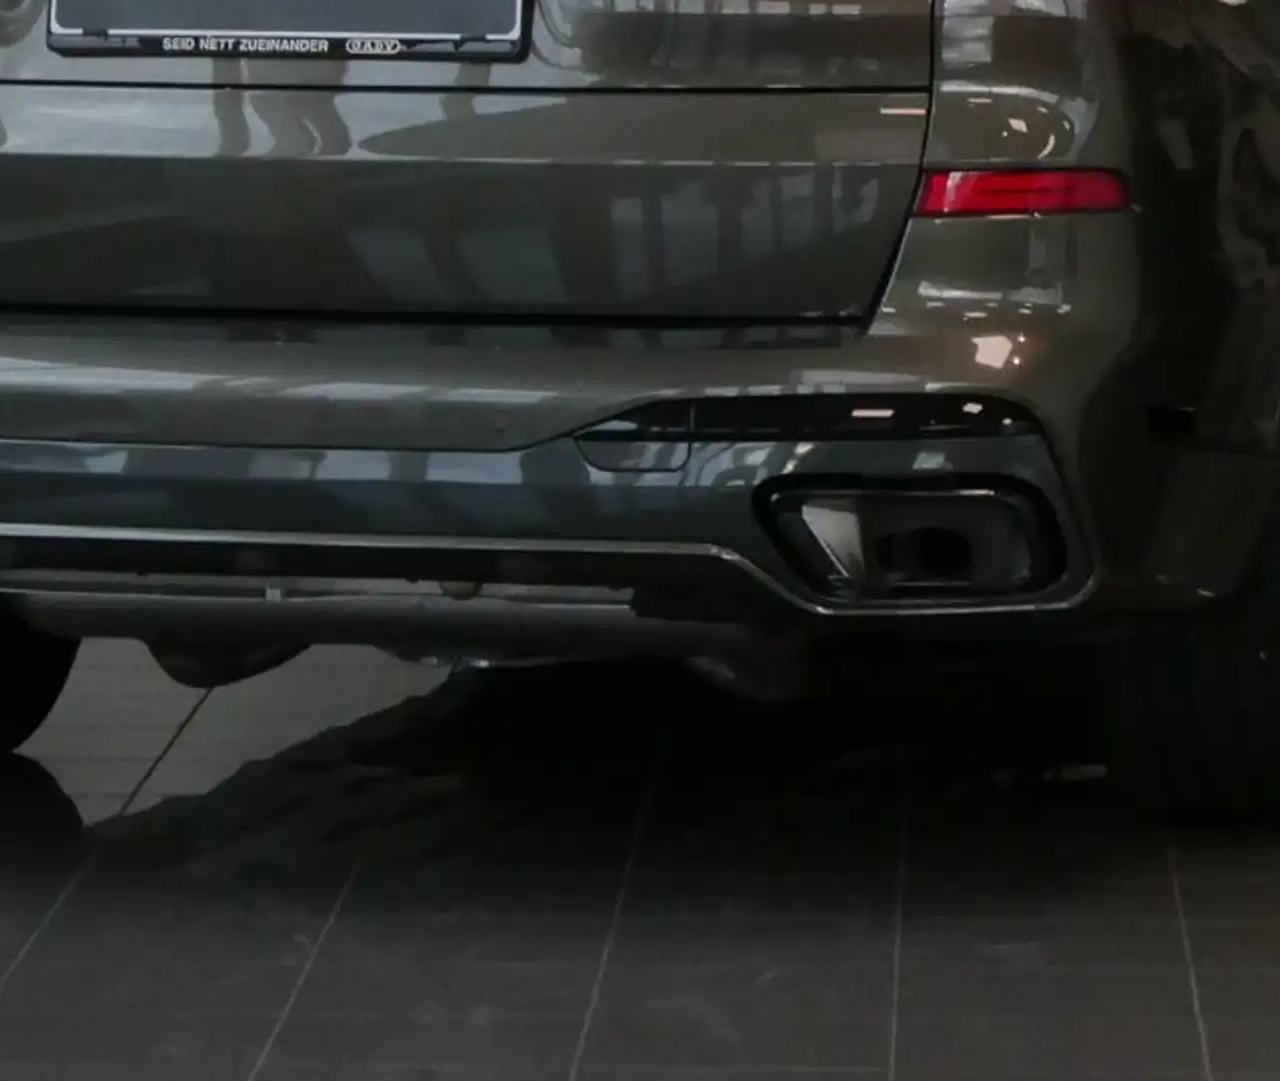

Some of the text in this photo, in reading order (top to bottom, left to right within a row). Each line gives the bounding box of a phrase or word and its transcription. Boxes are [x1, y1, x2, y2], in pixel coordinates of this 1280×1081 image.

[162, 37, 329, 53] SEID NETT ZUEINANDER
